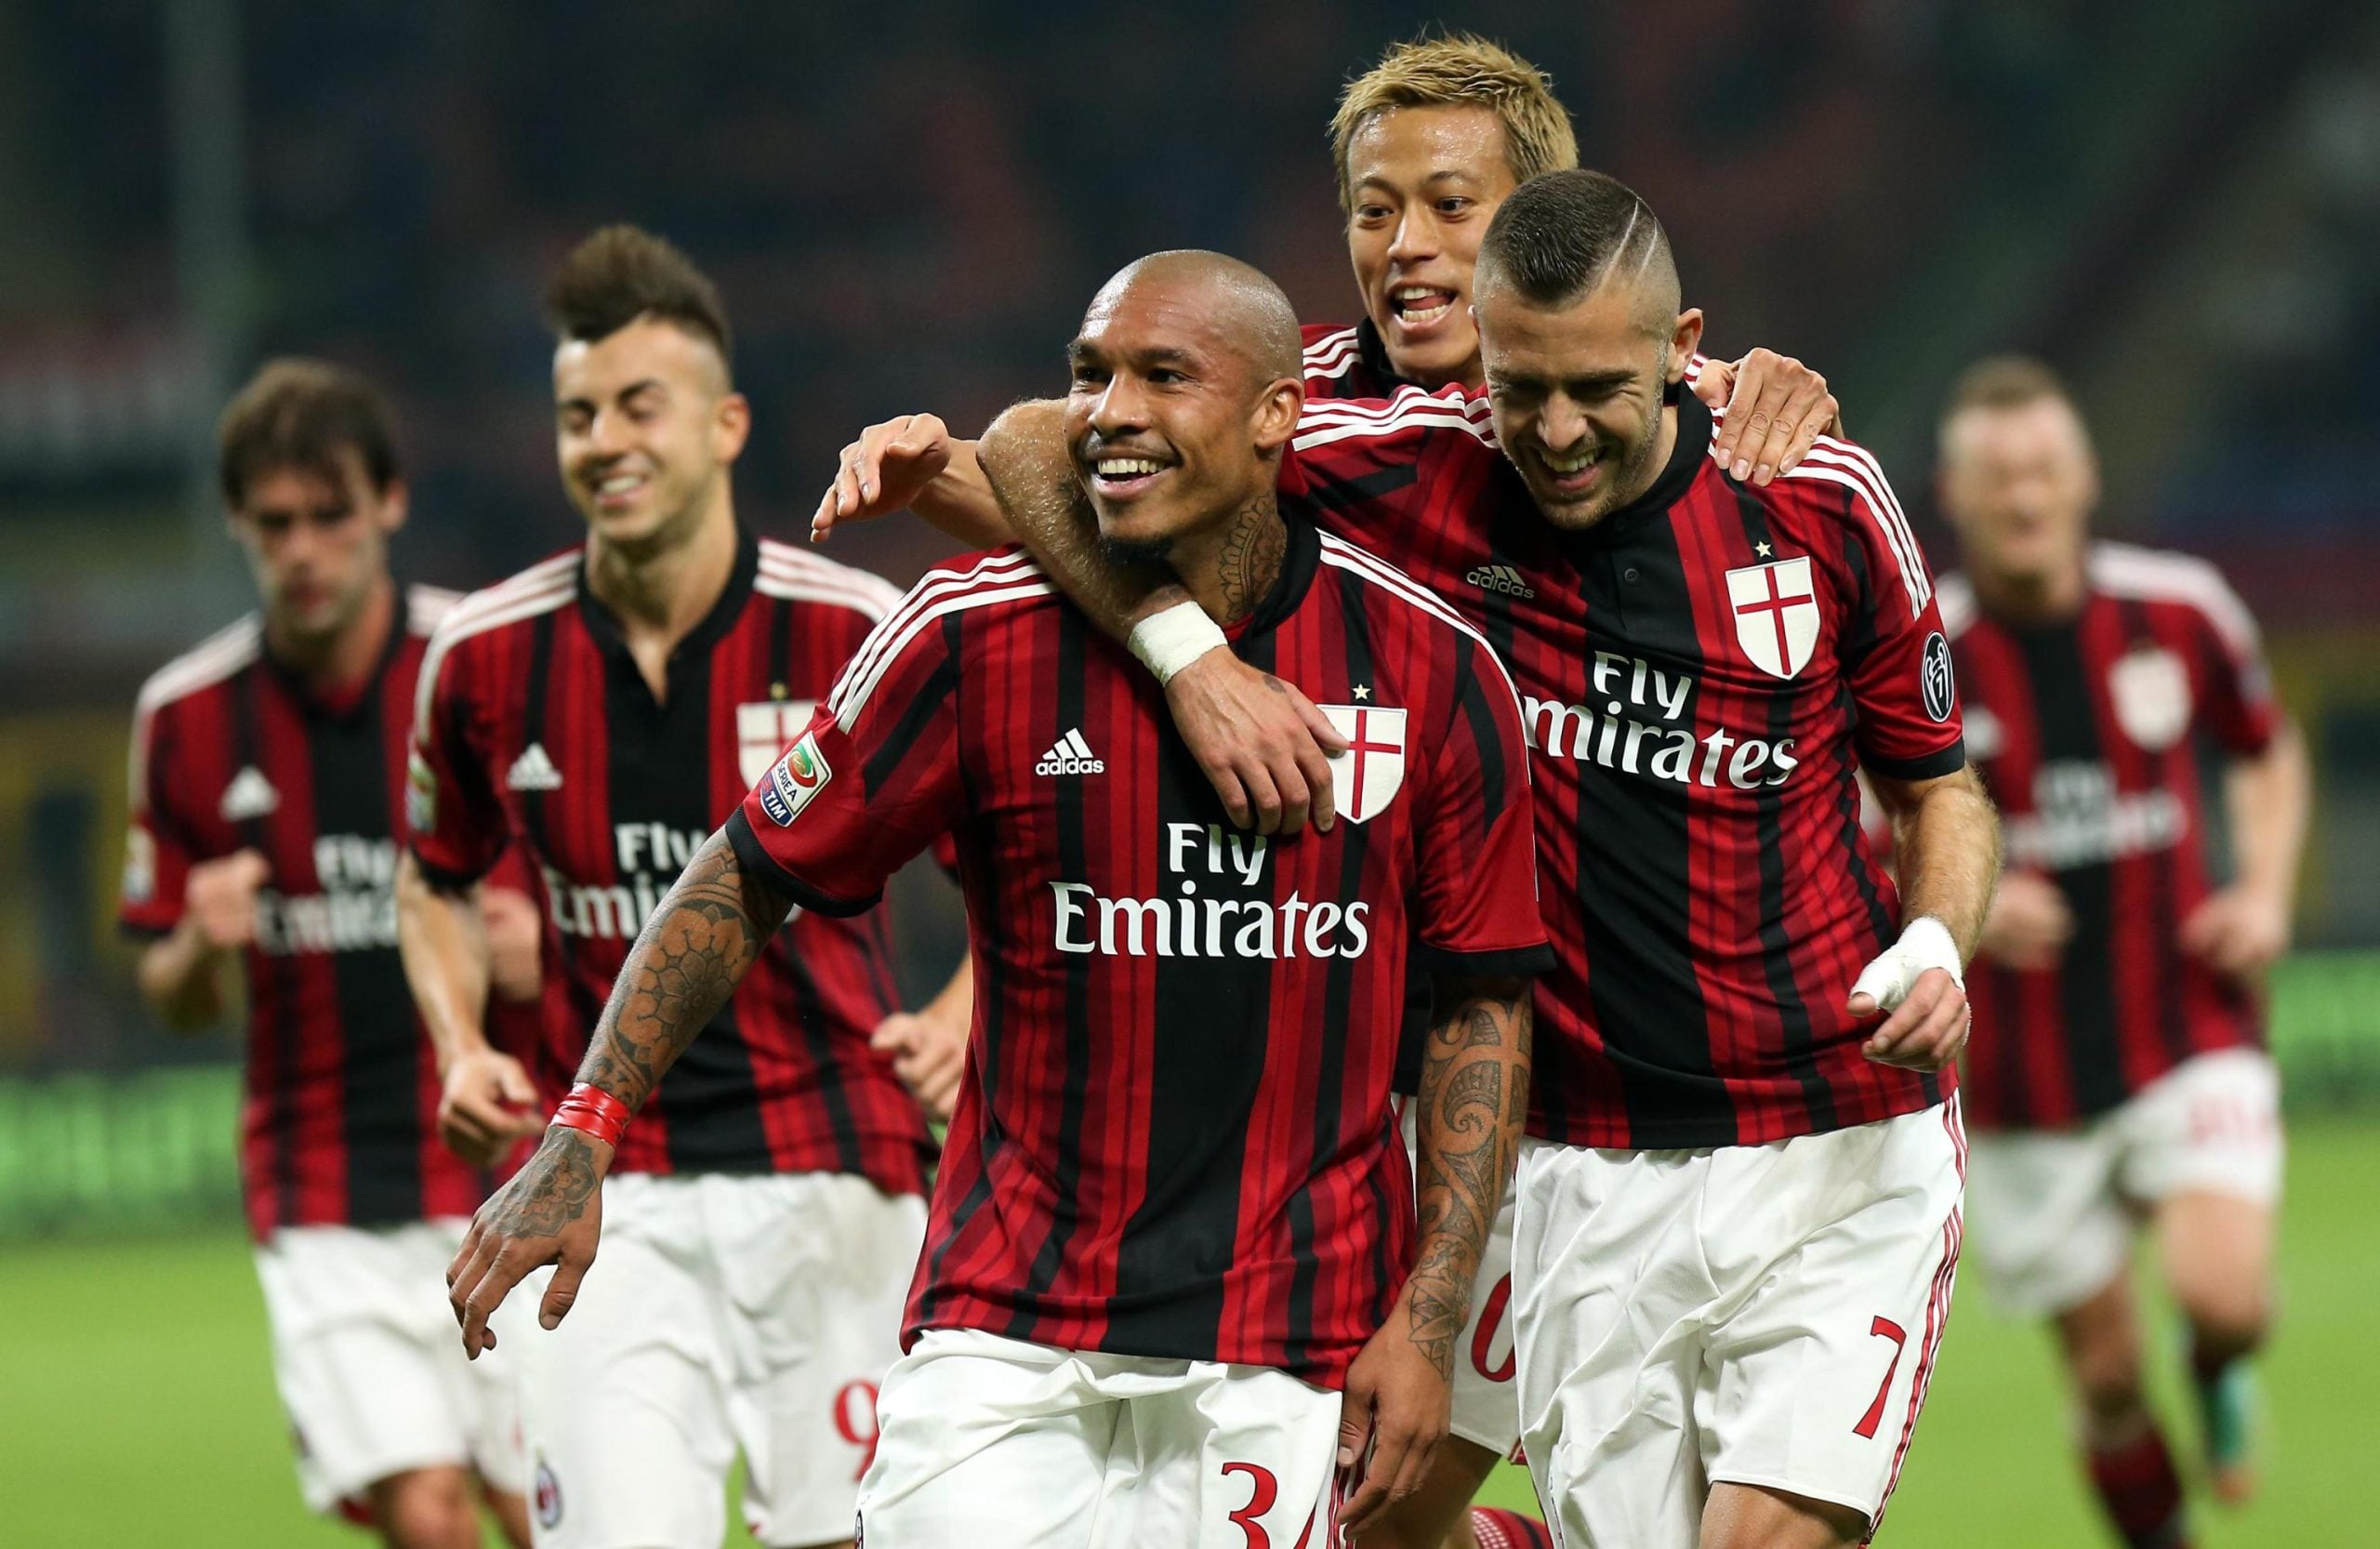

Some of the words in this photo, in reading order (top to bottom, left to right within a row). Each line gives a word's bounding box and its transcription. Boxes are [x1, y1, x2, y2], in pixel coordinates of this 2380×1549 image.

[1466, 571, 1535, 599] adidas
[1593, 650, 1692, 721] Fly
[1035, 758, 1104, 776] adidas
[1525, 695, 1800, 790] mirates
[765, 790, 787, 819] TIM
[778, 761, 793, 790] SERIE
[787, 789, 798, 801] A
[1167, 822, 1267, 886] Fly
[1048, 880, 1369, 960] Emirates
[1852, 1315, 1907, 1440] 7
[833, 1379, 879, 1483] 9
[1221, 1462, 1316, 1549] 3
